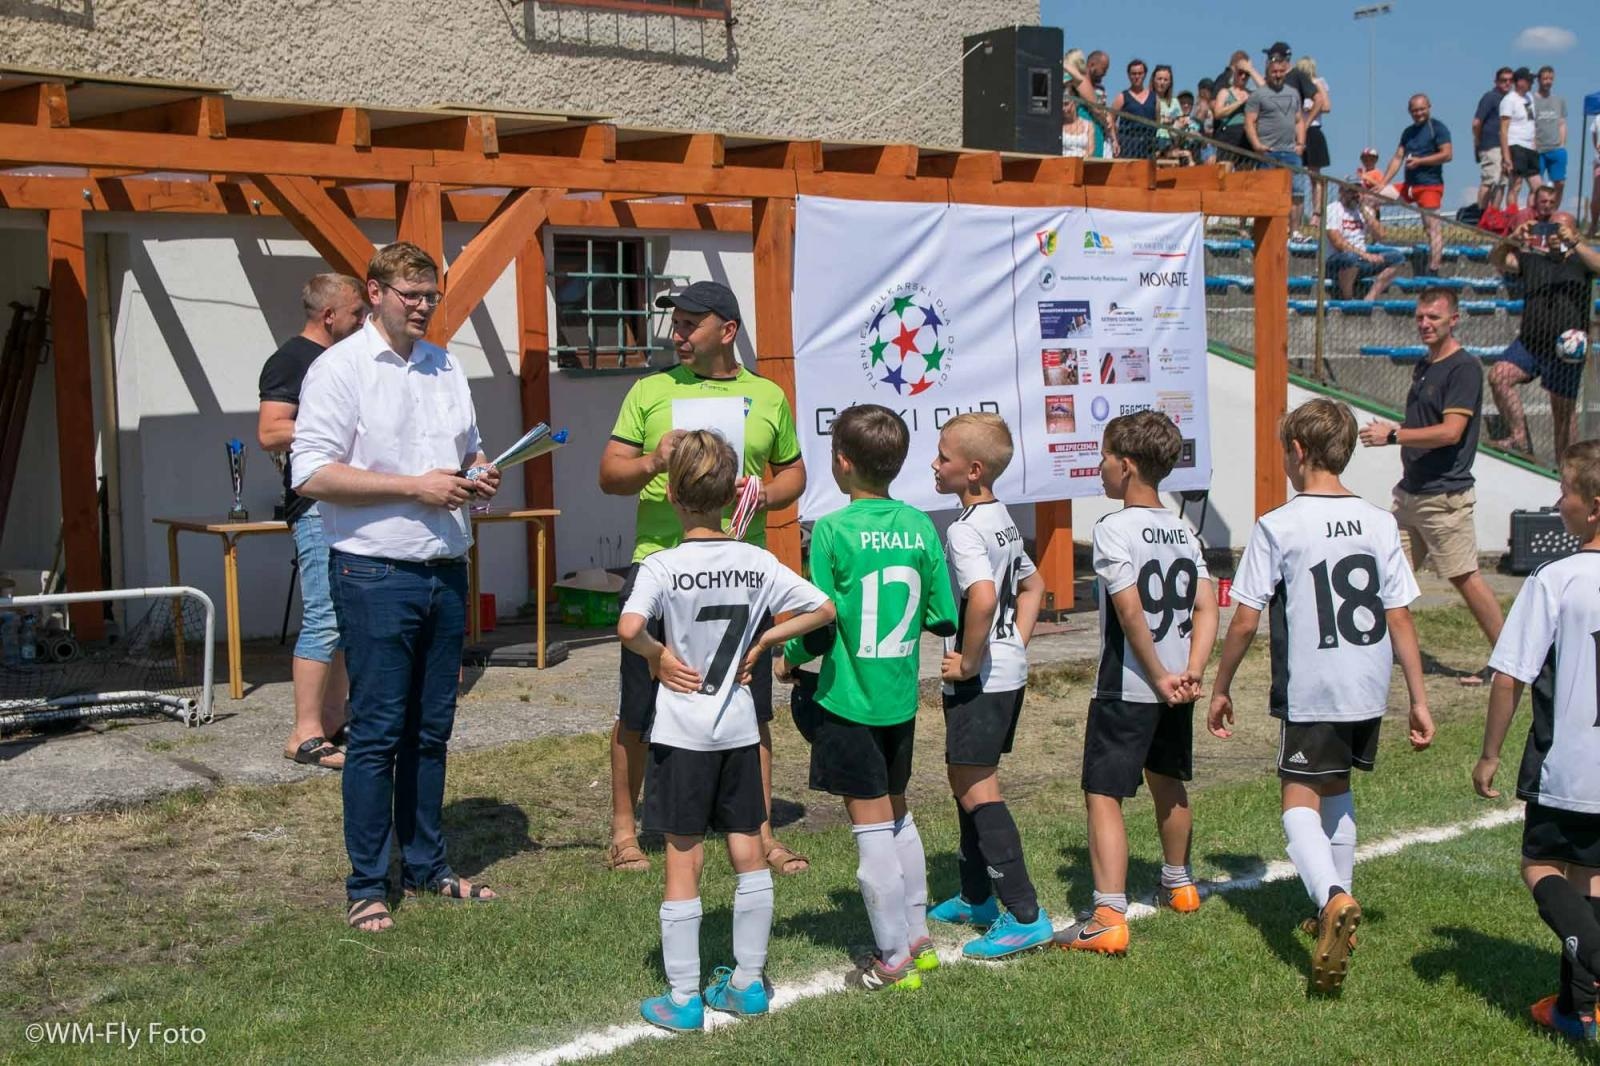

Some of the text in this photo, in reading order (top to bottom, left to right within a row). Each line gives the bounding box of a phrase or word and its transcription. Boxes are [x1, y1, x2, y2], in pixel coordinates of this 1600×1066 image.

[1139, 271, 1190, 288] MOKATE
[860, 281, 955, 391] TURNIEJ PIŁKARSKI DLA DZIECI
[859, 531, 926, 554] PĘKALA
[1325, 519, 1363, 538] JAN
[672, 569, 765, 591] JOCHYMEK
[856, 565, 921, 659] 12
[1137, 557, 1198, 643] 99
[1309, 553, 1387, 650] 18
[695, 604, 750, 696] 7
